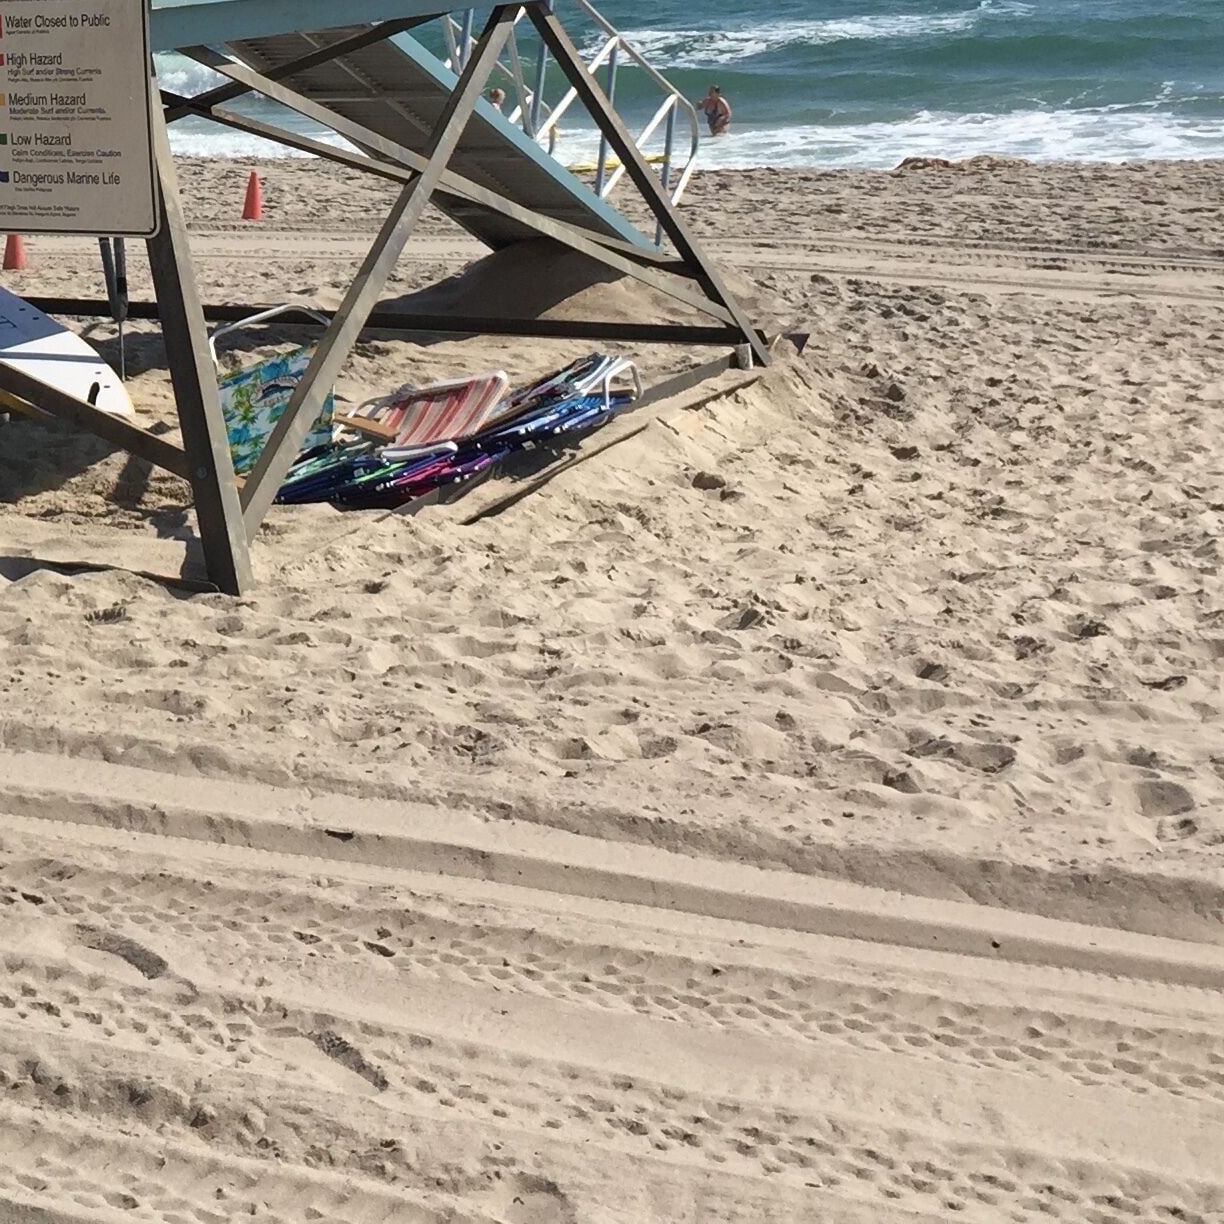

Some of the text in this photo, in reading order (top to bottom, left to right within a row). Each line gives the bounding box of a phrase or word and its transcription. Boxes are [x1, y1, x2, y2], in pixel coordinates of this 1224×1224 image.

[5, 13, 111, 28] Water Closed to Public
[6, 52, 62, 69] High Hazard
[8, 92, 86, 106] Medium Hazard
[11, 132, 72, 146] Low Hazard
[13, 170, 121, 187] Dangerous Marine Life
